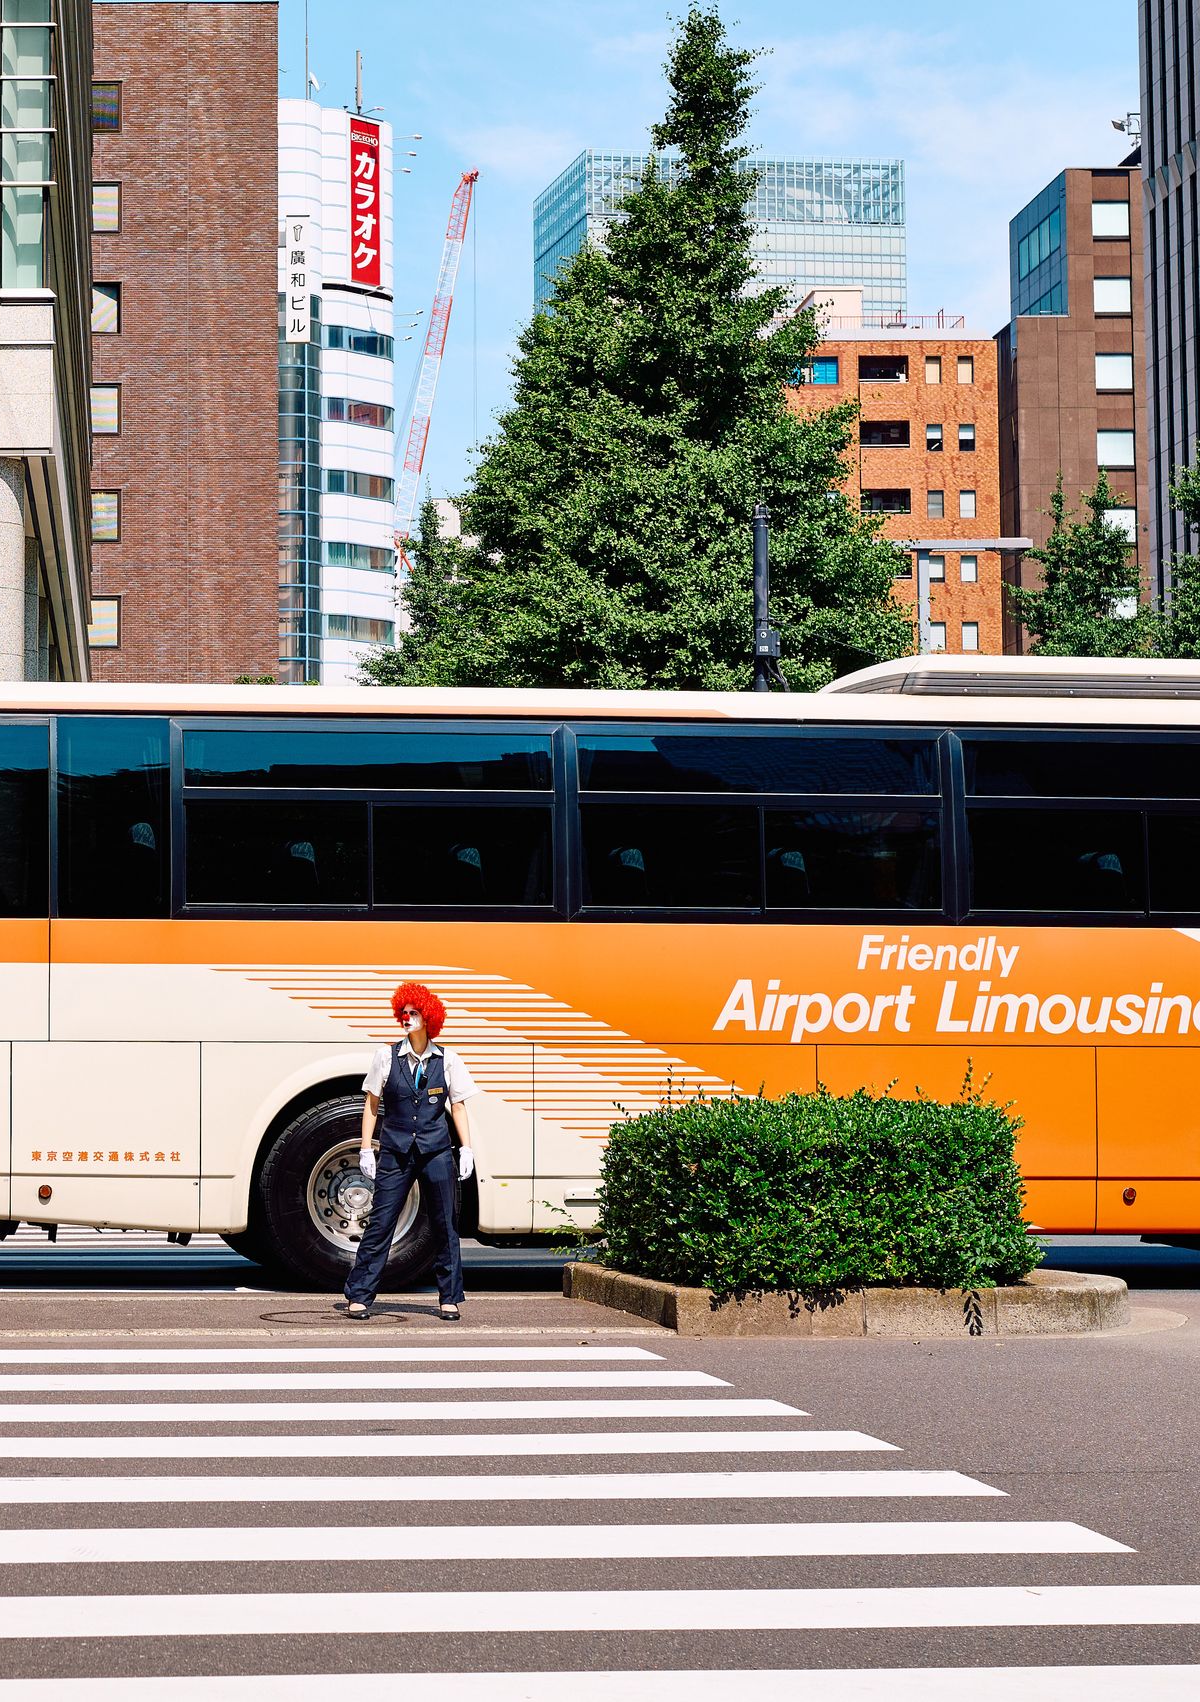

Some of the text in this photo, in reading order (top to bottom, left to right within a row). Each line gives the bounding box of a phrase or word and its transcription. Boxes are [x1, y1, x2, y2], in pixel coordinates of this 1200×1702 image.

[354, 152, 377, 269] カラオケ
[290, 250, 306, 333] 廣和ビル
[857, 934, 1020, 978] Friendly
[712, 979, 1200, 1043] Airport Limousin
[31, 1150, 181, 1162] 東京空港交通株式会社
